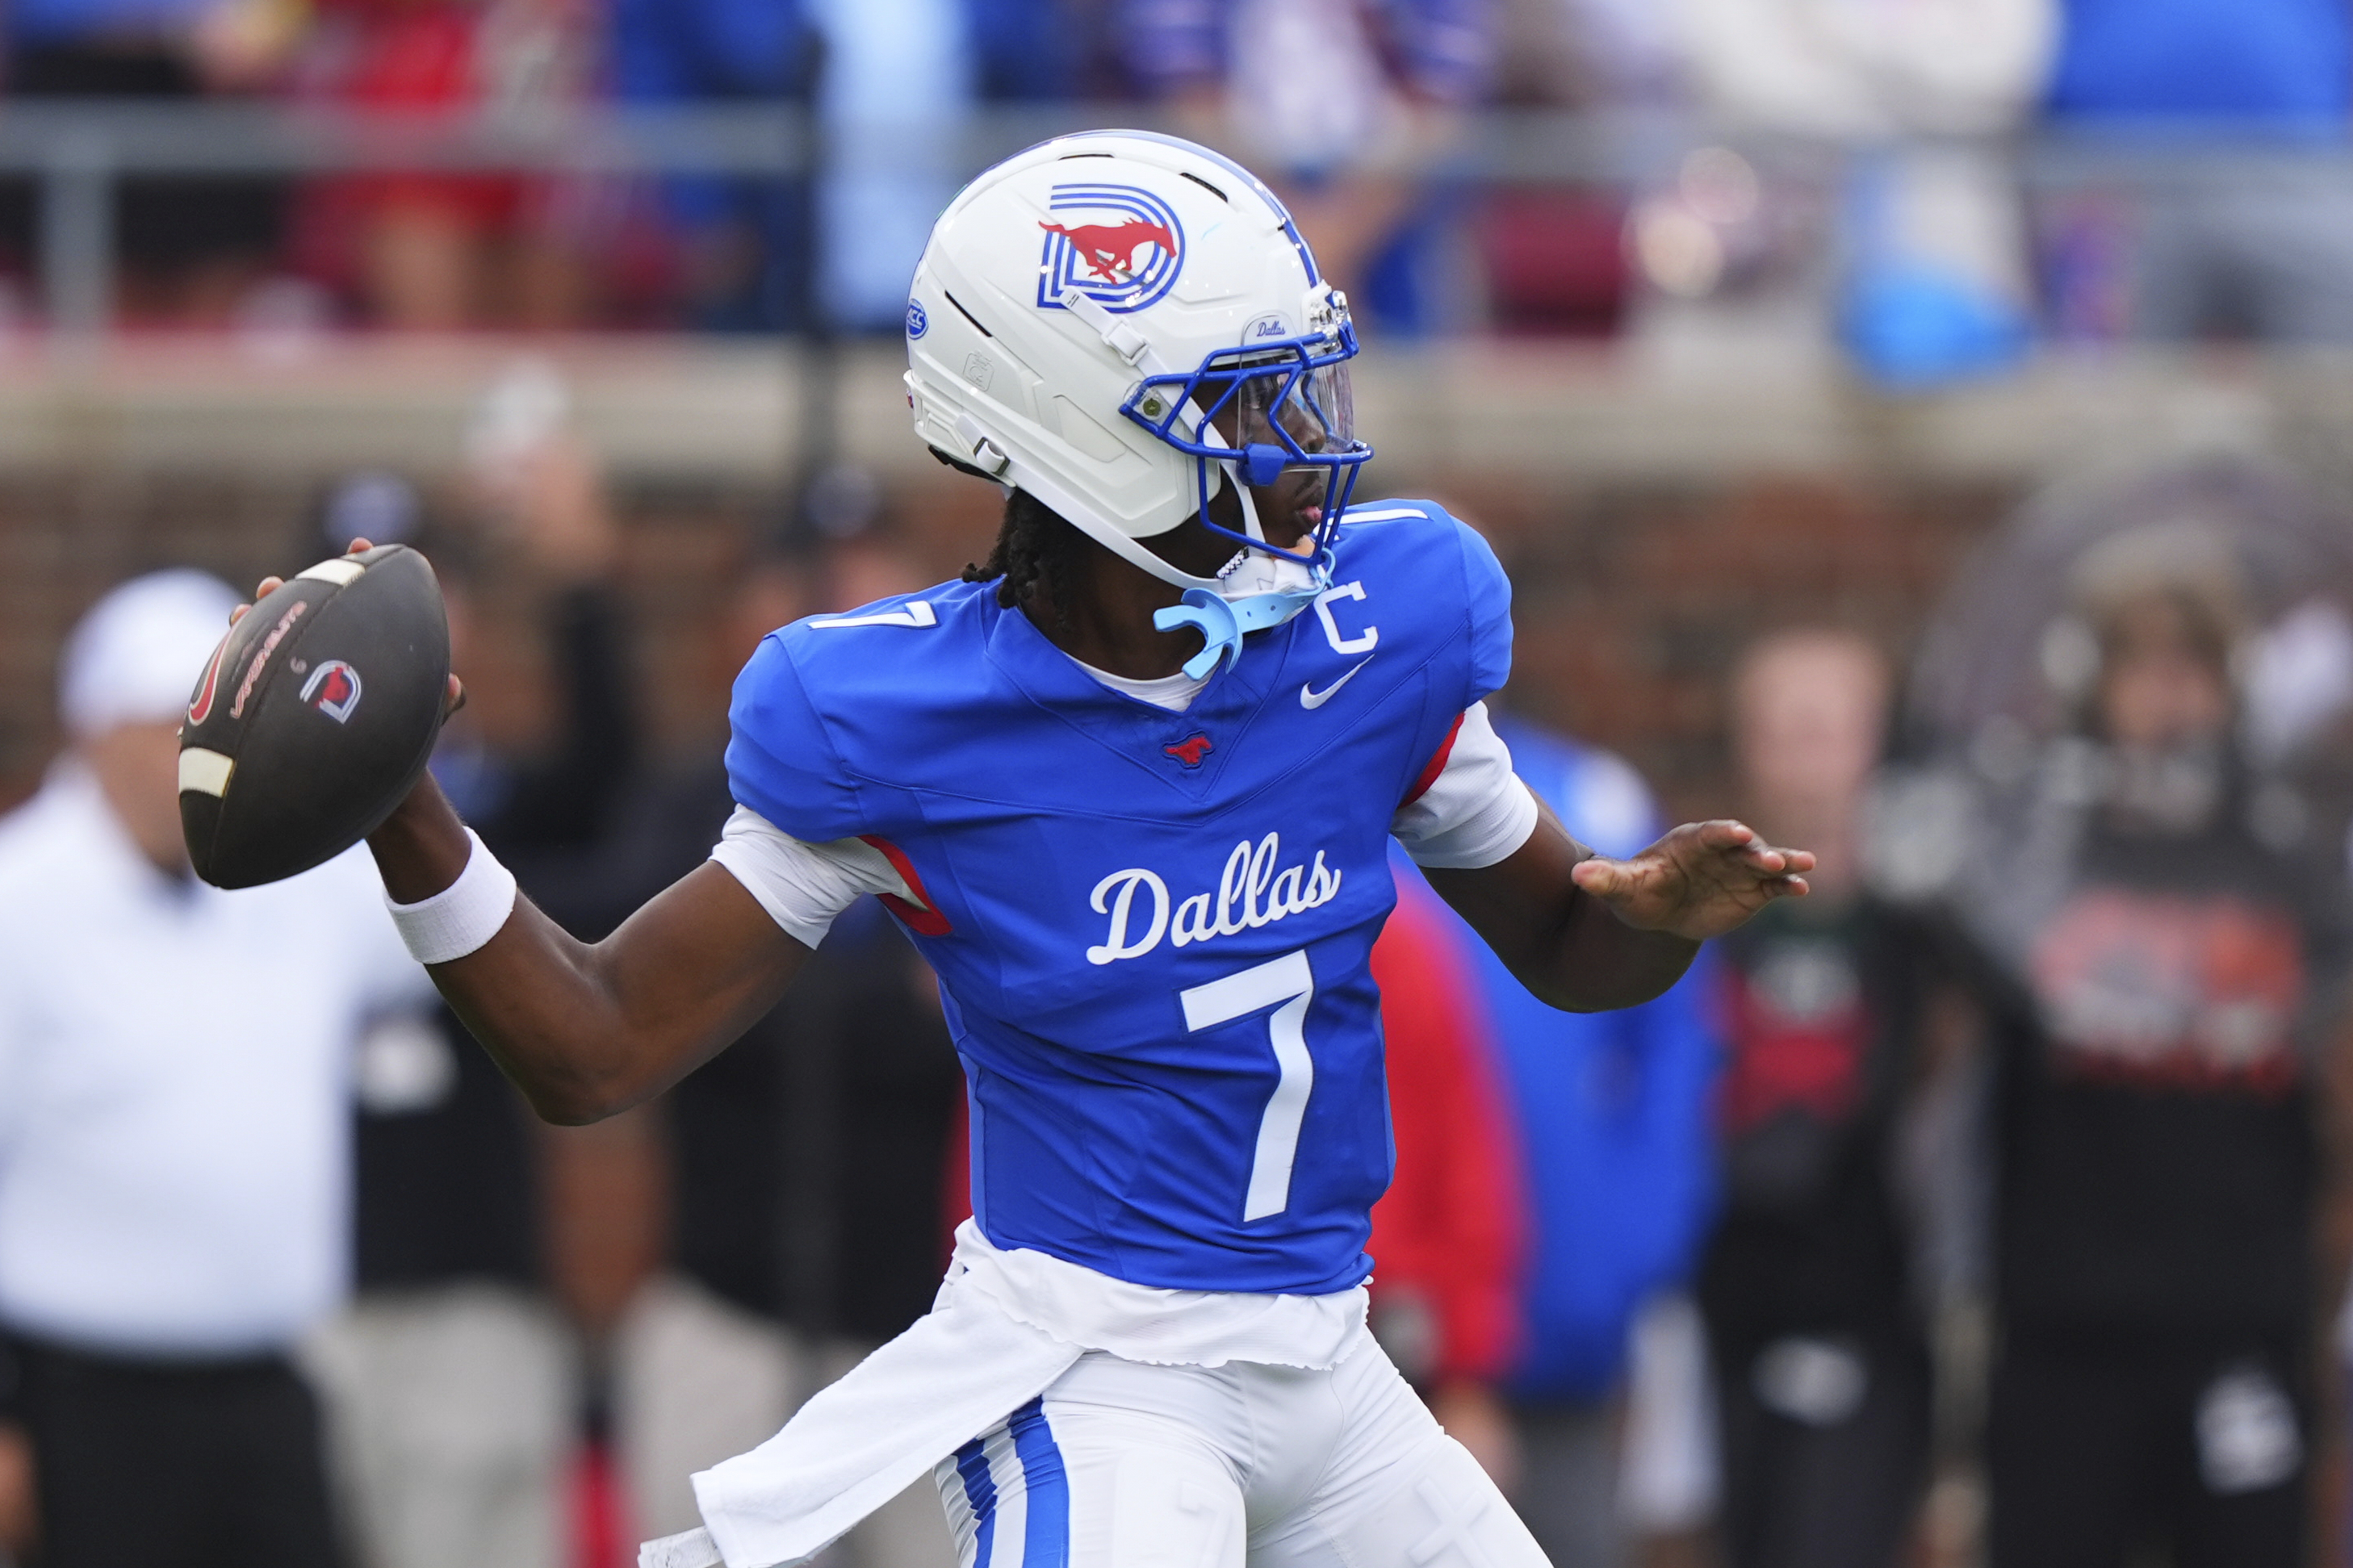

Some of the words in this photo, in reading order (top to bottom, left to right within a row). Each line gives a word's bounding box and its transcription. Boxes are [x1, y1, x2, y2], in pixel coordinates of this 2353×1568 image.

[1257, 320, 1286, 337] Dallas
[1313, 581, 1380, 654] C
[1086, 831, 1342, 965] Dallas
[1179, 949, 1314, 1223] 7
